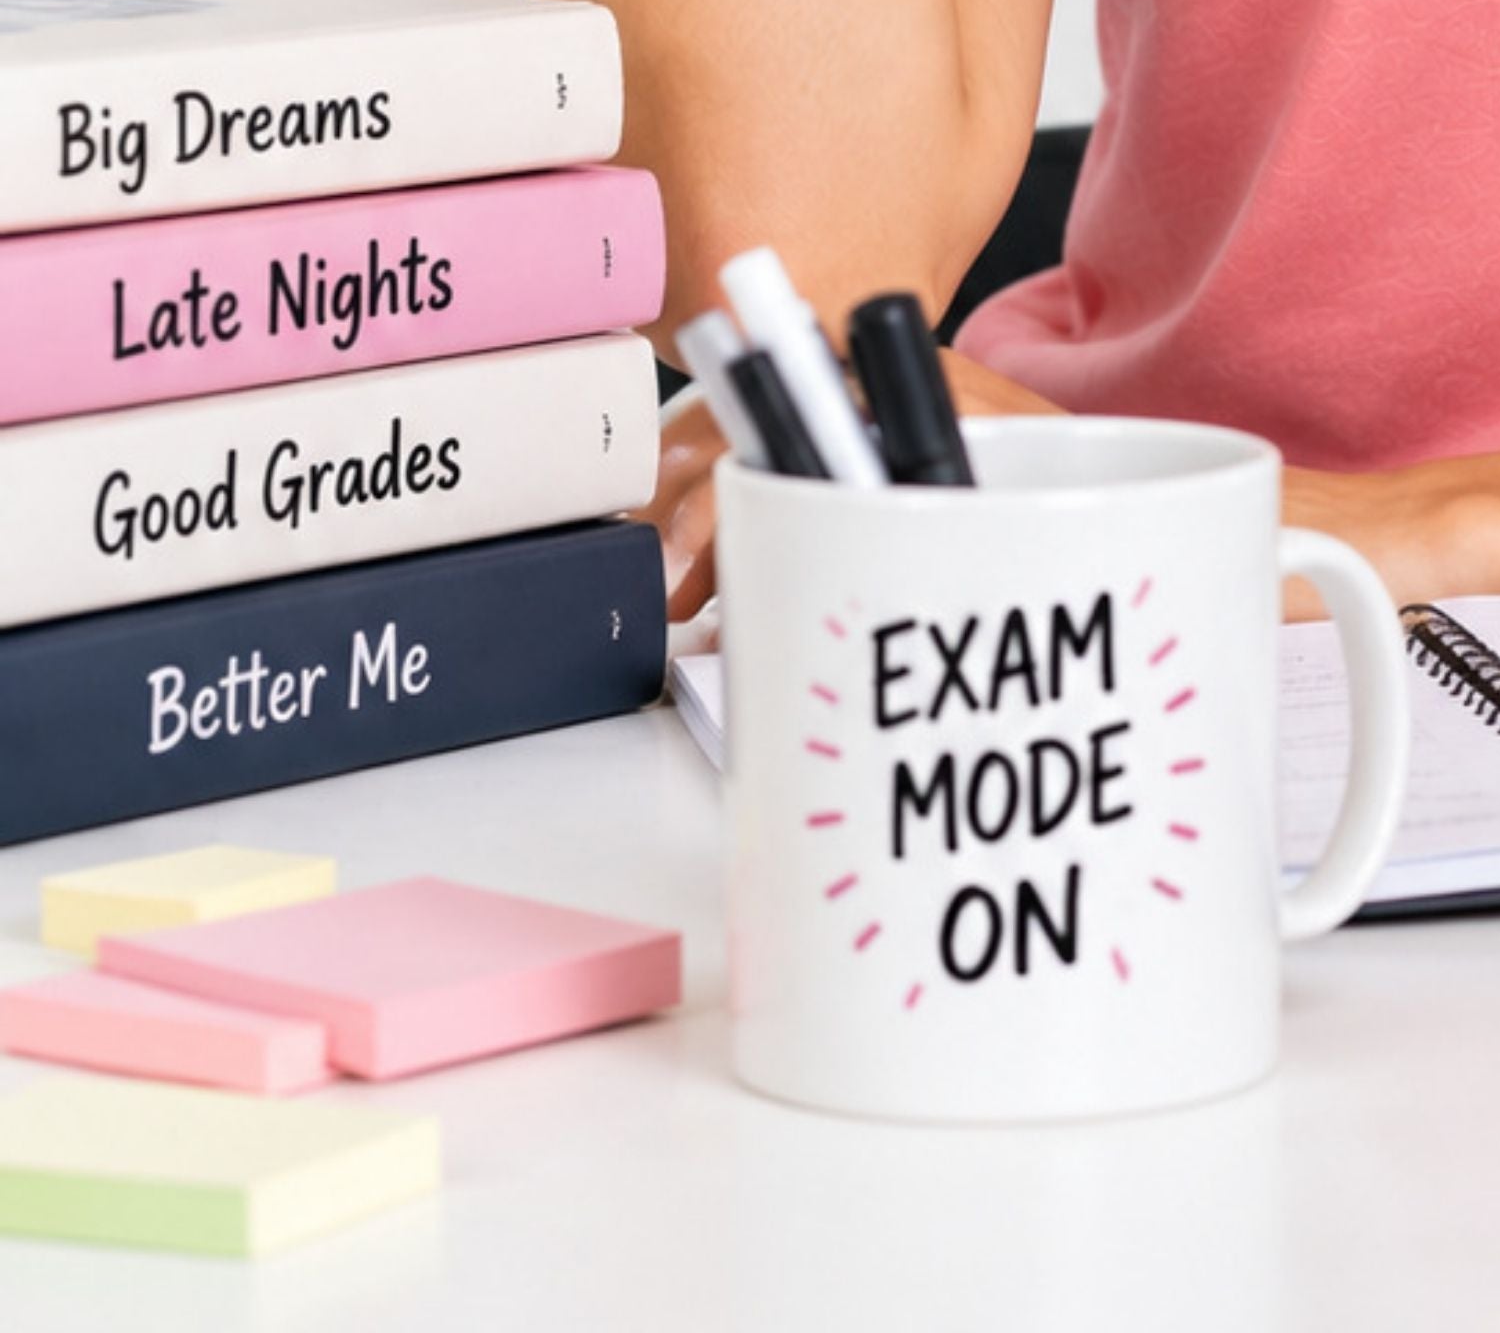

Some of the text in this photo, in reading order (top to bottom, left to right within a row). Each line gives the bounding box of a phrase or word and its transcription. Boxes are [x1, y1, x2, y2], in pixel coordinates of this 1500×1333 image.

[57, 89, 392, 196] Big Dreams
[111, 236, 454, 362] Late Nights
[92, 416, 462, 561] Good Grades
[146, 621, 432, 755] Better Me
[871, 591, 1116, 731] EXAM
[891, 720, 1133, 860] MODE
[938, 863, 1082, 984] ON
